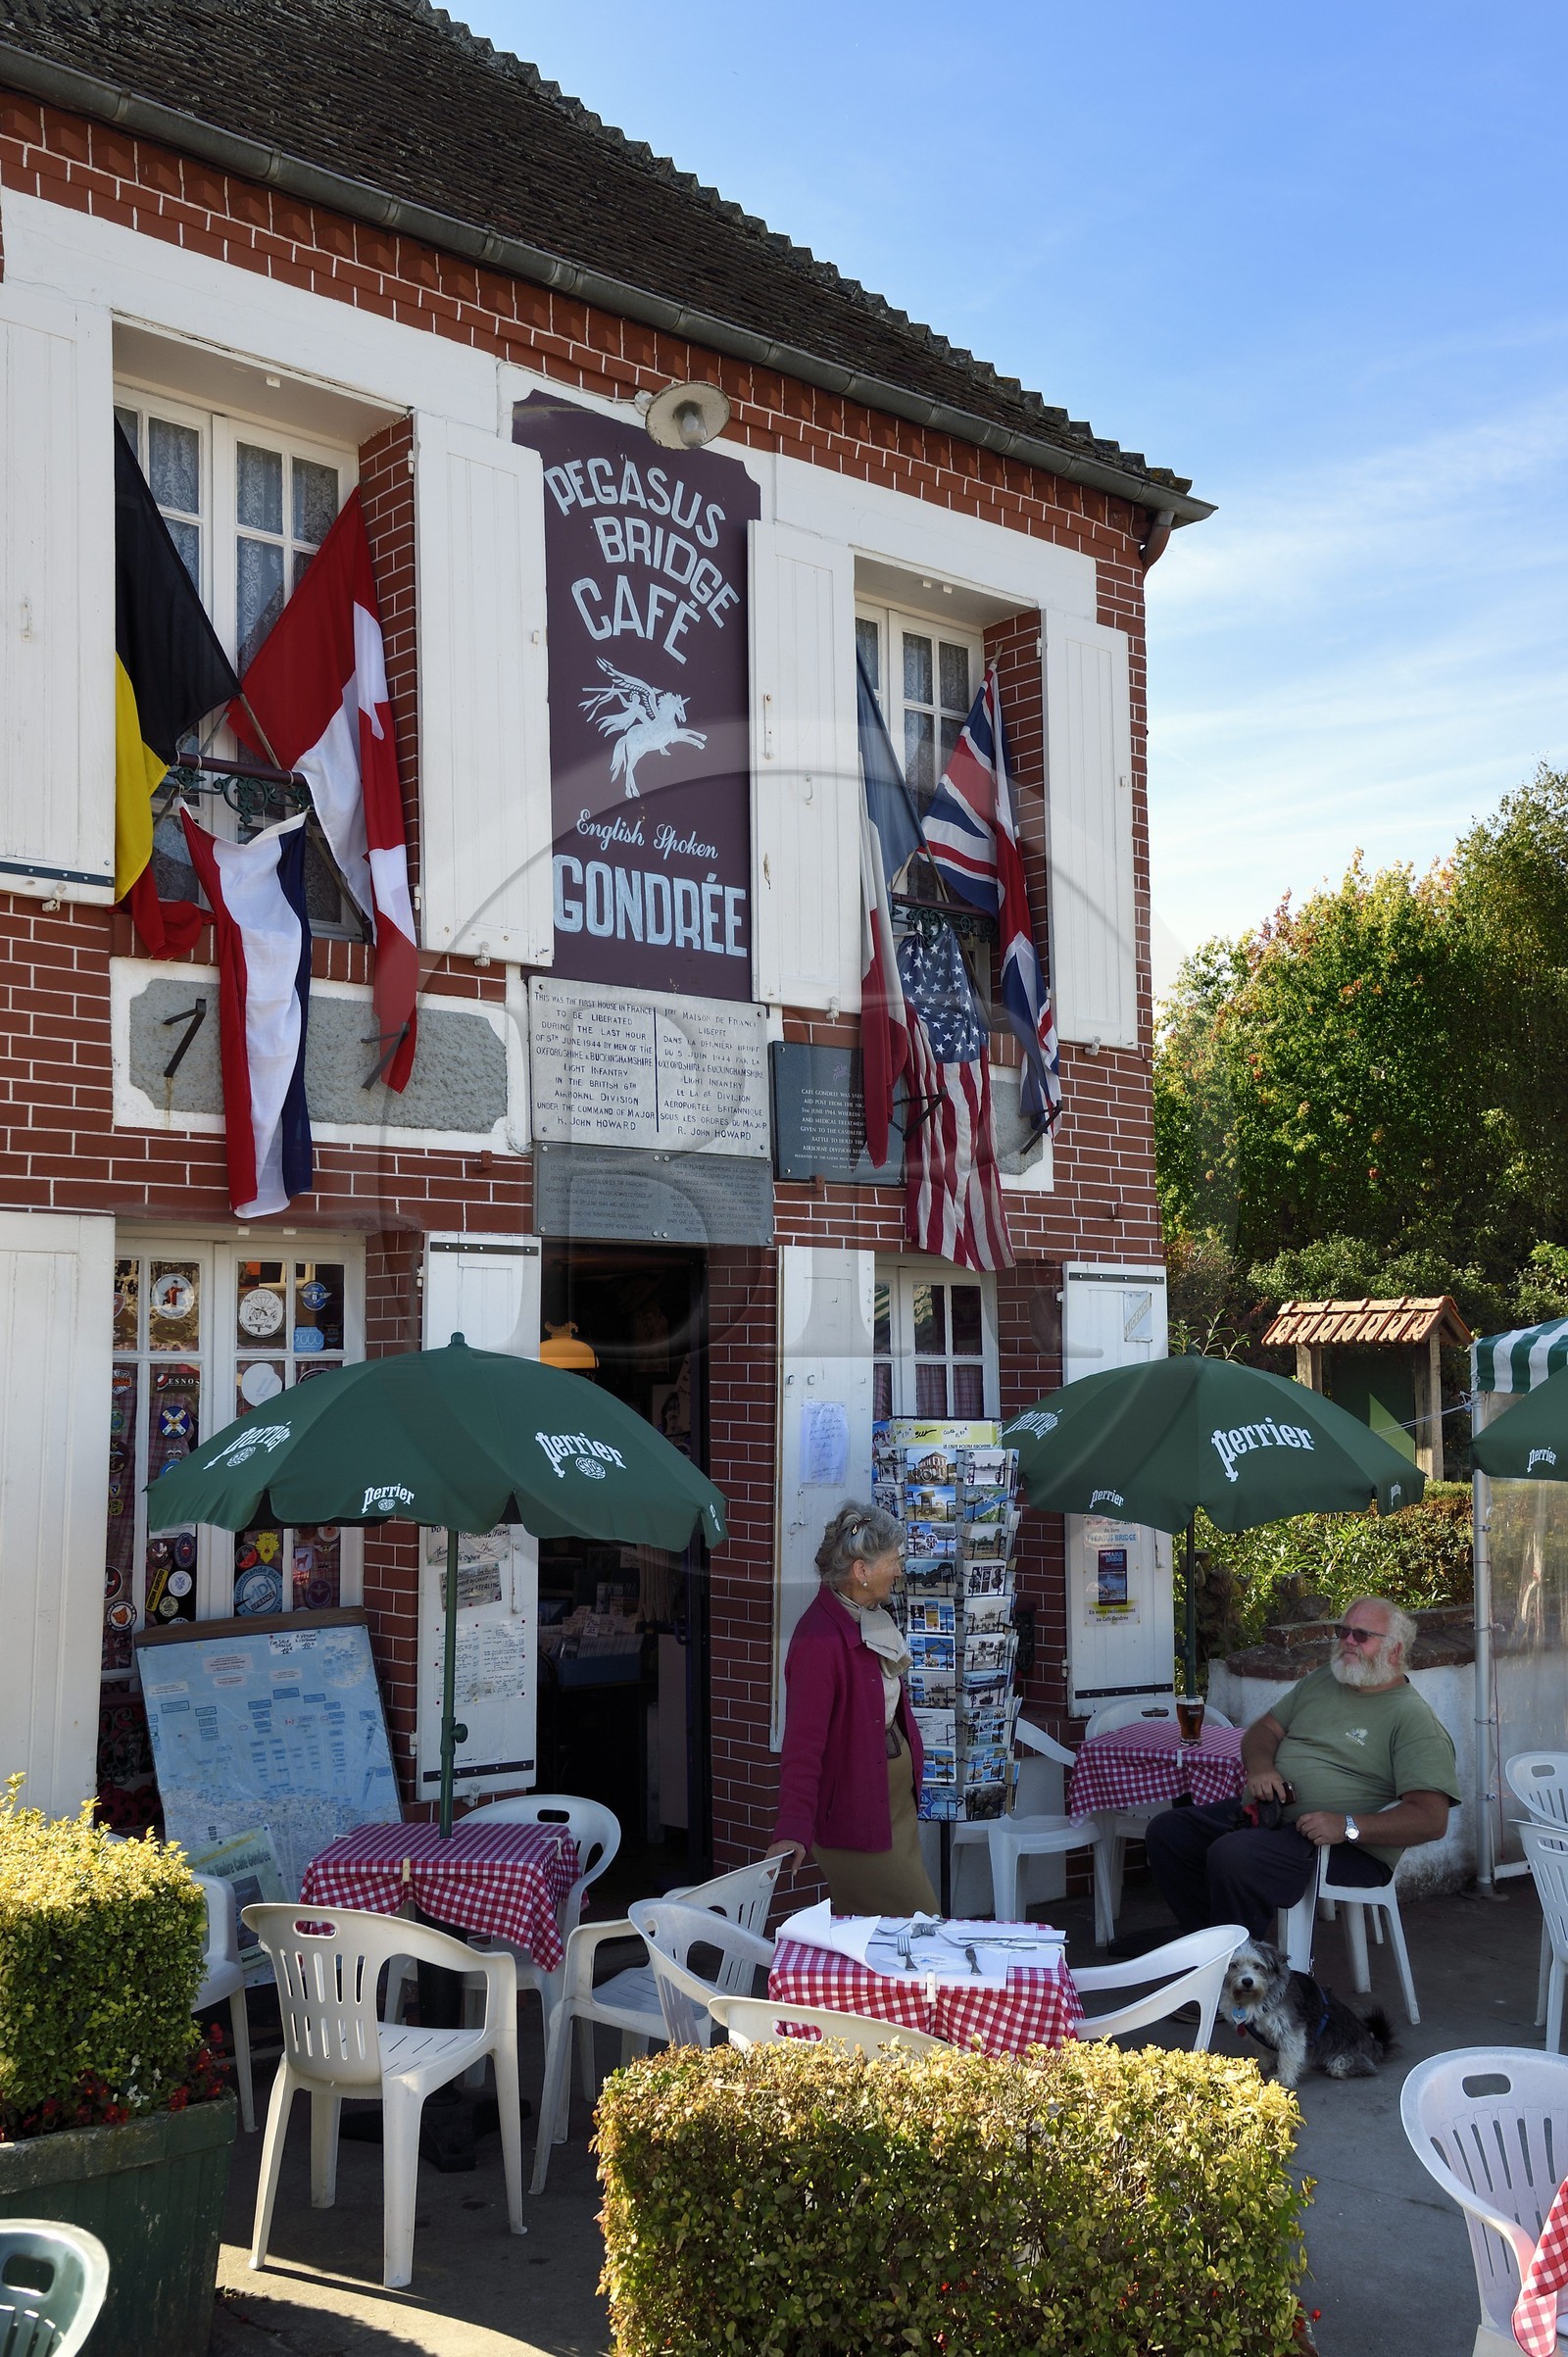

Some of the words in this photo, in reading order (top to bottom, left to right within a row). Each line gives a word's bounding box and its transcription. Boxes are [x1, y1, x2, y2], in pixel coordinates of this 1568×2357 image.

[543, 457, 726, 549] PEGASUS
[594, 516, 740, 628] BRIDGE
[571, 574, 702, 664] CAFÉ
[575, 808, 645, 847] English
[653, 823, 718, 859] Spoken
[552, 853, 748, 958] GONDRÉE
[591, 1013, 633, 1026] LIBERATED
[583, 1039, 601, 1048] 1944
[596, 1120, 636, 1131] HOWARD
[714, 1130, 752, 1140] HOWARD
[203, 1420, 292, 1470] perrier
[535, 1432, 627, 1478] perrier
[1211, 1416, 1314, 1483] perrier
[1527, 1447, 1557, 1473] perrier
[361, 1483, 416, 1514] perrier
[1089, 1489, 1125, 1509] perrier
[1114, 1533, 1137, 1542] BRIDGE
